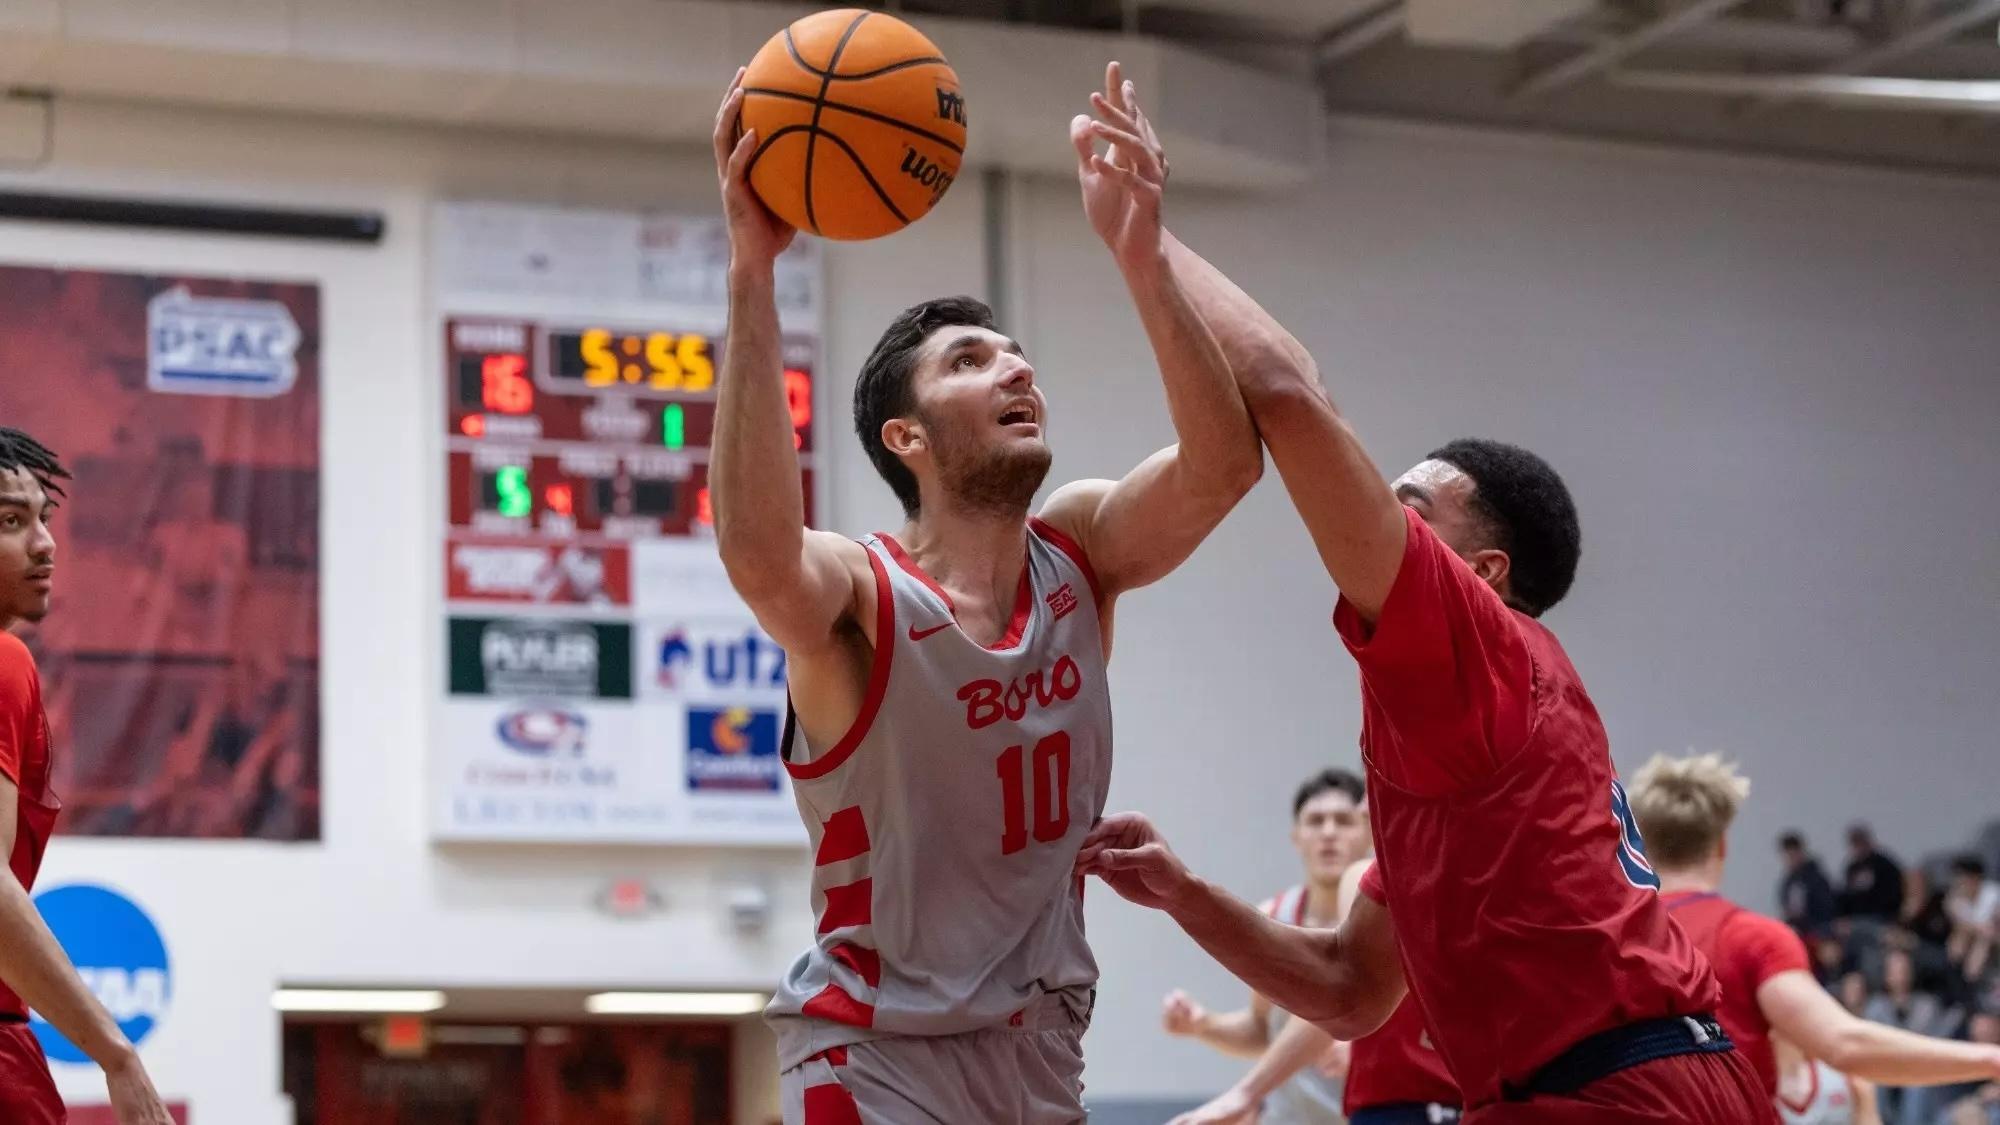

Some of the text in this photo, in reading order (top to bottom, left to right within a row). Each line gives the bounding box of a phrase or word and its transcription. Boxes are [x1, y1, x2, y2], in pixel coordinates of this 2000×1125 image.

[482, 354, 533, 416] 16
[580, 328, 714, 392] 5:55
[663, 403, 684, 450] 1
[496, 465, 532, 518] 5
[956, 654, 1081, 730] Boro
[996, 729, 1071, 856] 10
